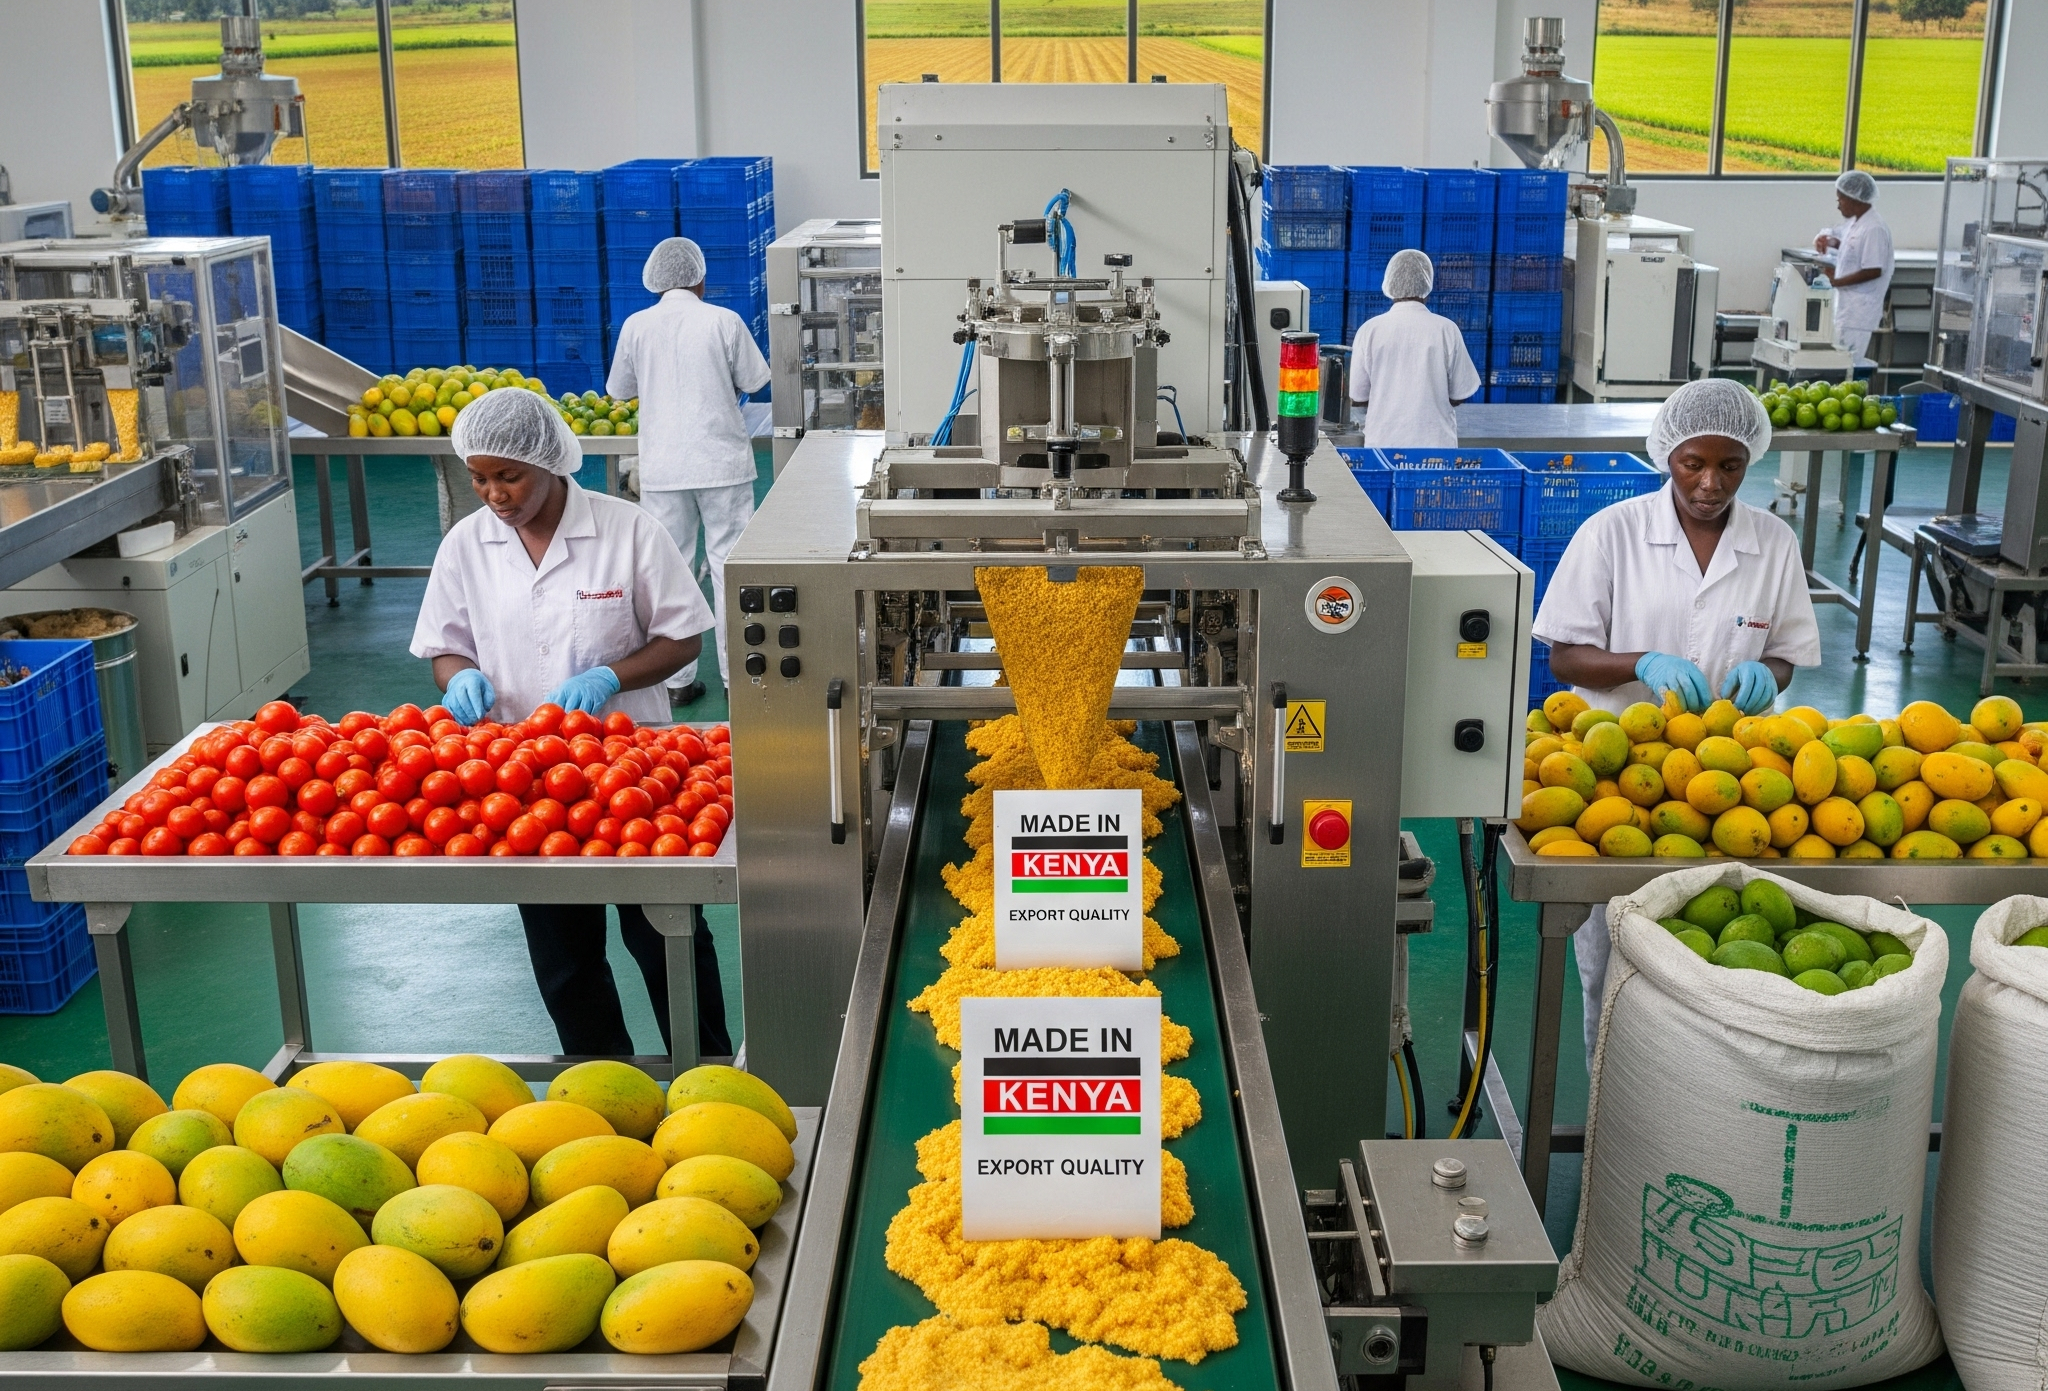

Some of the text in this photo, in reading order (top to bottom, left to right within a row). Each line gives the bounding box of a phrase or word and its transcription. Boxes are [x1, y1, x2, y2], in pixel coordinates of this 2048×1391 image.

[1020, 813, 1121, 833] MADE IN
[1022, 853, 1121, 877] KENYA
[1009, 908, 1130, 922] EXPORT QUALITY
[994, 1027, 1132, 1053] MADE IN
[999, 1081, 1132, 1112] KENYA
[977, 1158, 1145, 1177] EXPORT QUALITY
